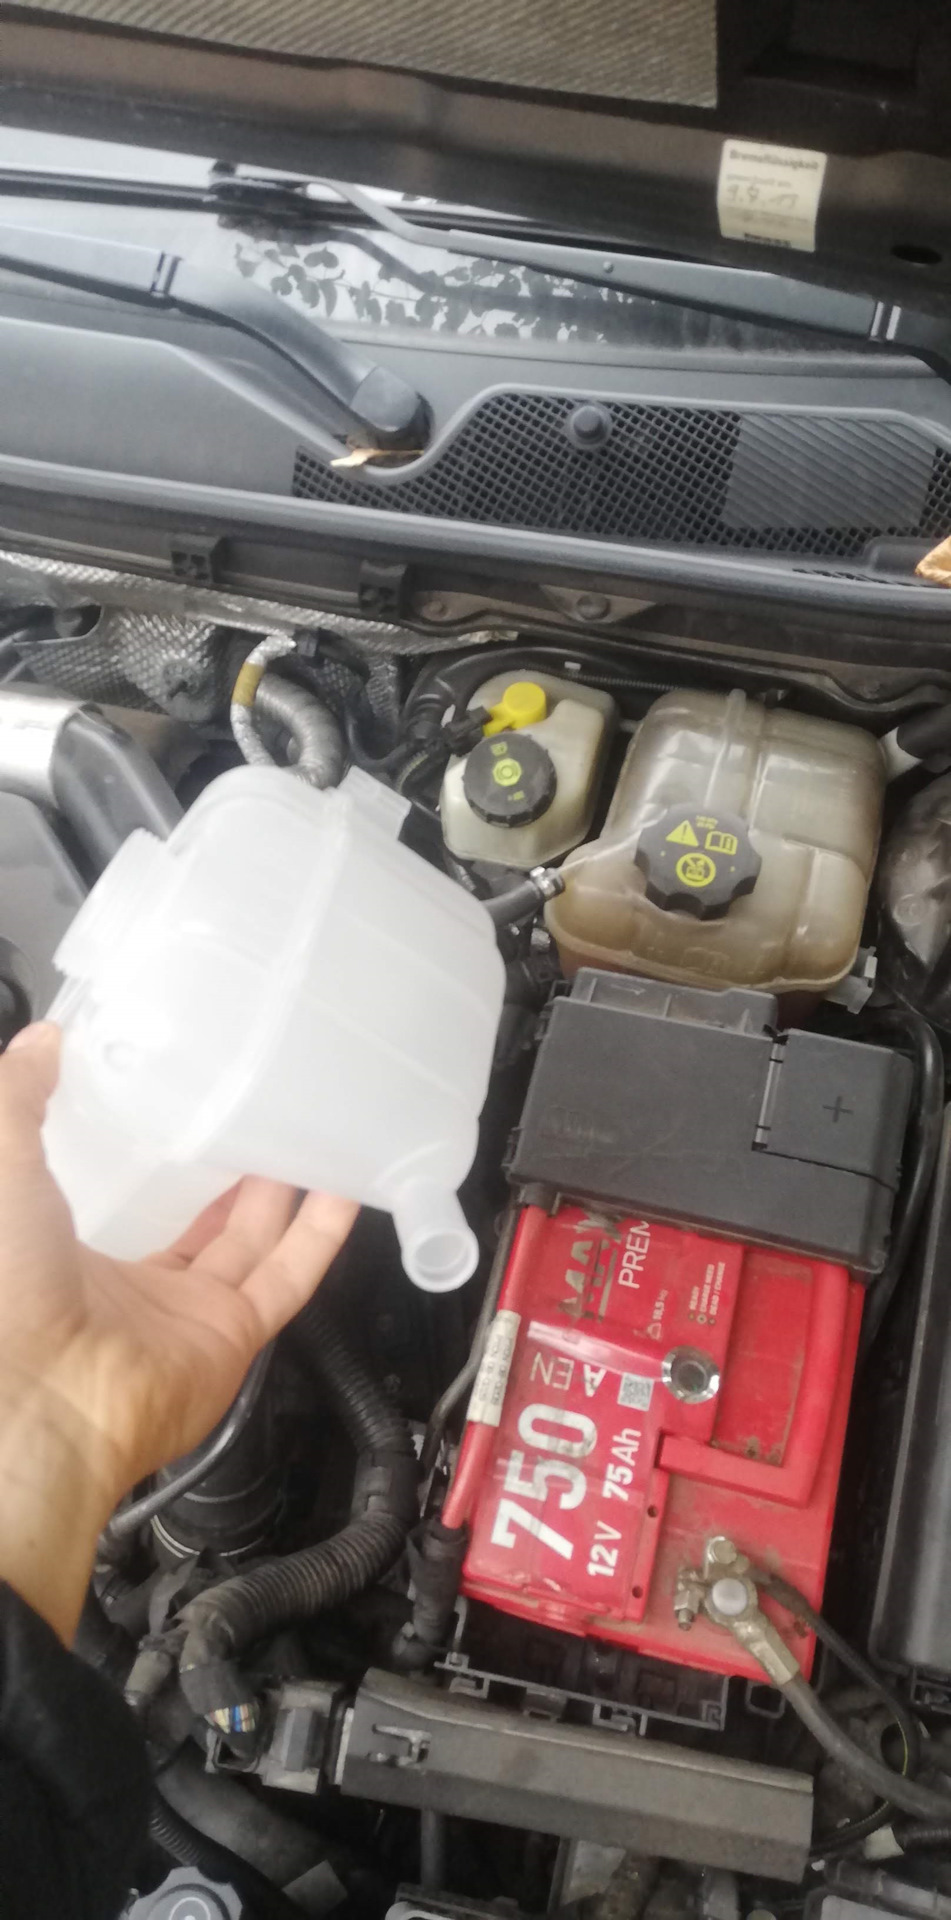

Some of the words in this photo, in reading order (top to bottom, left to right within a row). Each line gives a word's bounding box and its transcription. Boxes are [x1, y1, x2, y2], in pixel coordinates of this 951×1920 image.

[530, 1351, 575, 1391] EN
[583, 1364, 606, 1397] A
[491, 1404, 597, 1560] 750
